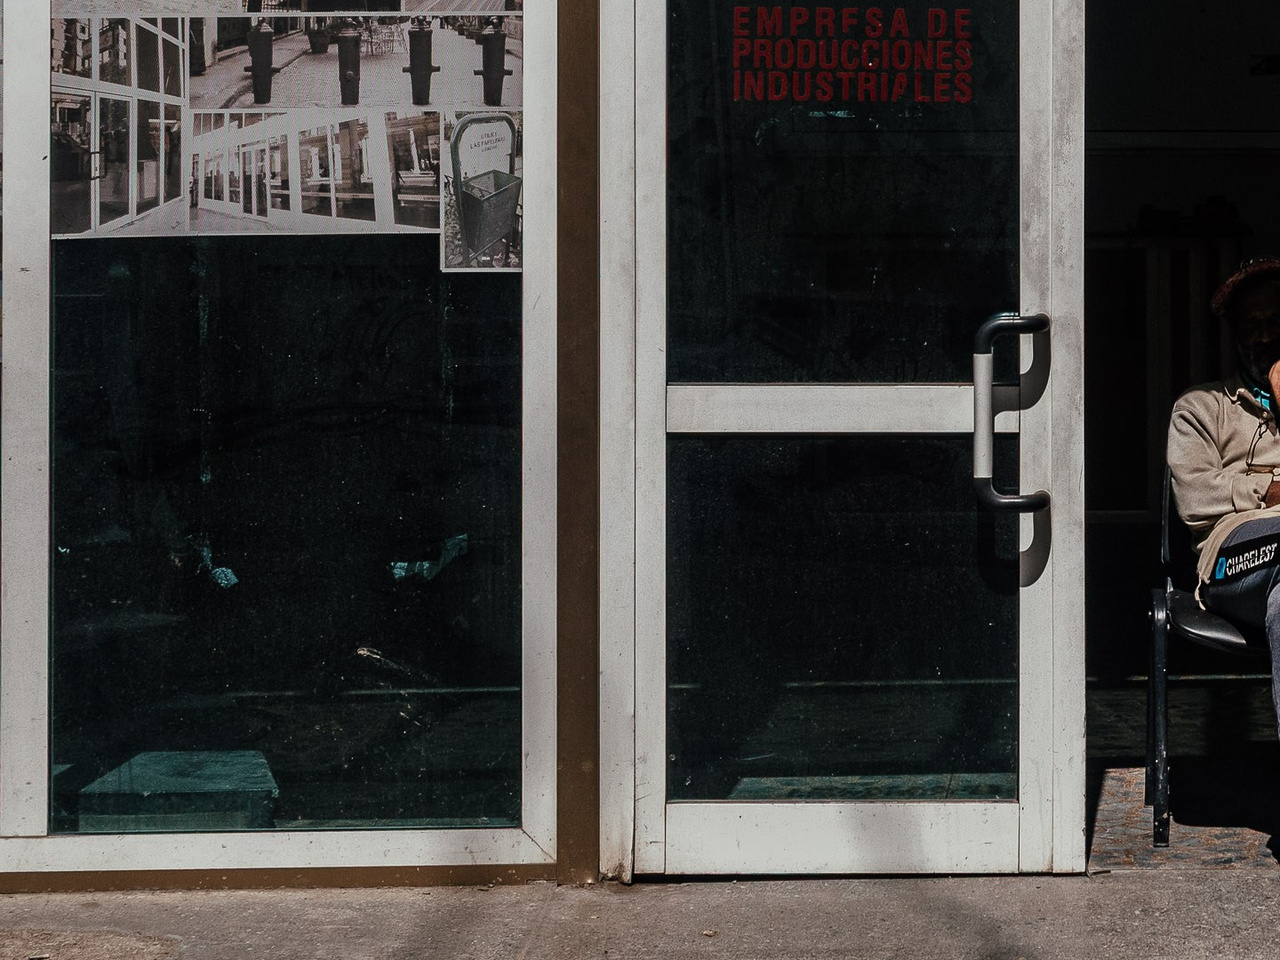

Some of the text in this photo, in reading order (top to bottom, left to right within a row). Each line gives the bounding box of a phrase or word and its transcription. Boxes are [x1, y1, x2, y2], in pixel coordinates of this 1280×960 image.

[928, 8, 972, 39] DE
[733, 38, 974, 71] PRODUCCIONES
[733, 70, 973, 103] INDUSTRIALES
